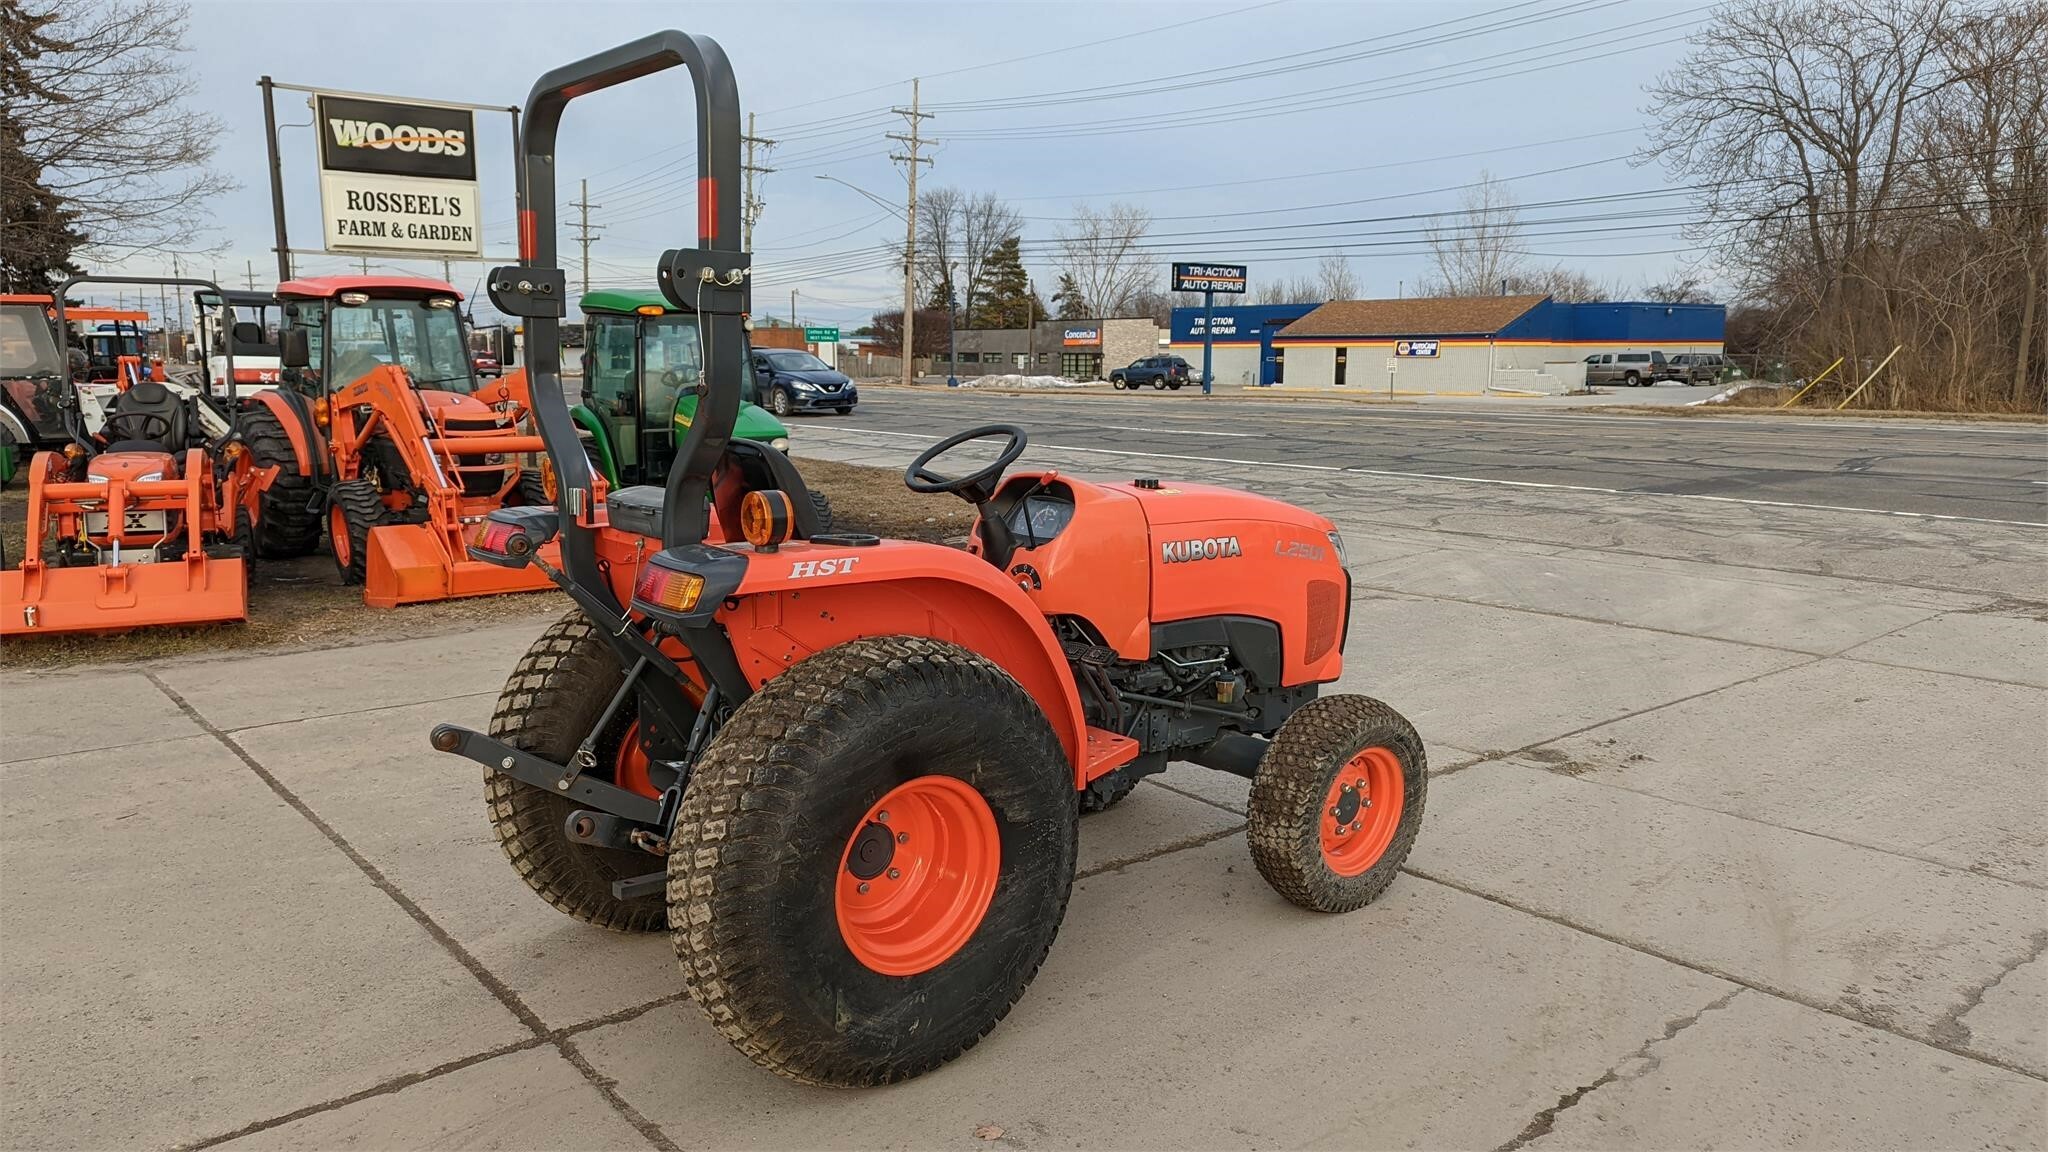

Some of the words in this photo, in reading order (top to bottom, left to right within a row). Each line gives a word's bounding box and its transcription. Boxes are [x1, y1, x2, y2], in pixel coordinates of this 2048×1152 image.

[329, 118, 467, 157] WOODS
[346, 189, 462, 217] ROSSEEL'S
[337, 219, 387, 238] FARM
[391, 222, 404, 238] &
[407, 223, 473, 242] GARDEN
[1182, 280, 1209, 290] AUTO
[1211, 281, 1244, 291] REPAIR
[1190, 327, 1206, 335] AUT
[1211, 327, 1237, 335] REPAIR
[1162, 535, 1242, 564] KUBOTA
[787, 556, 860, 579] HST
